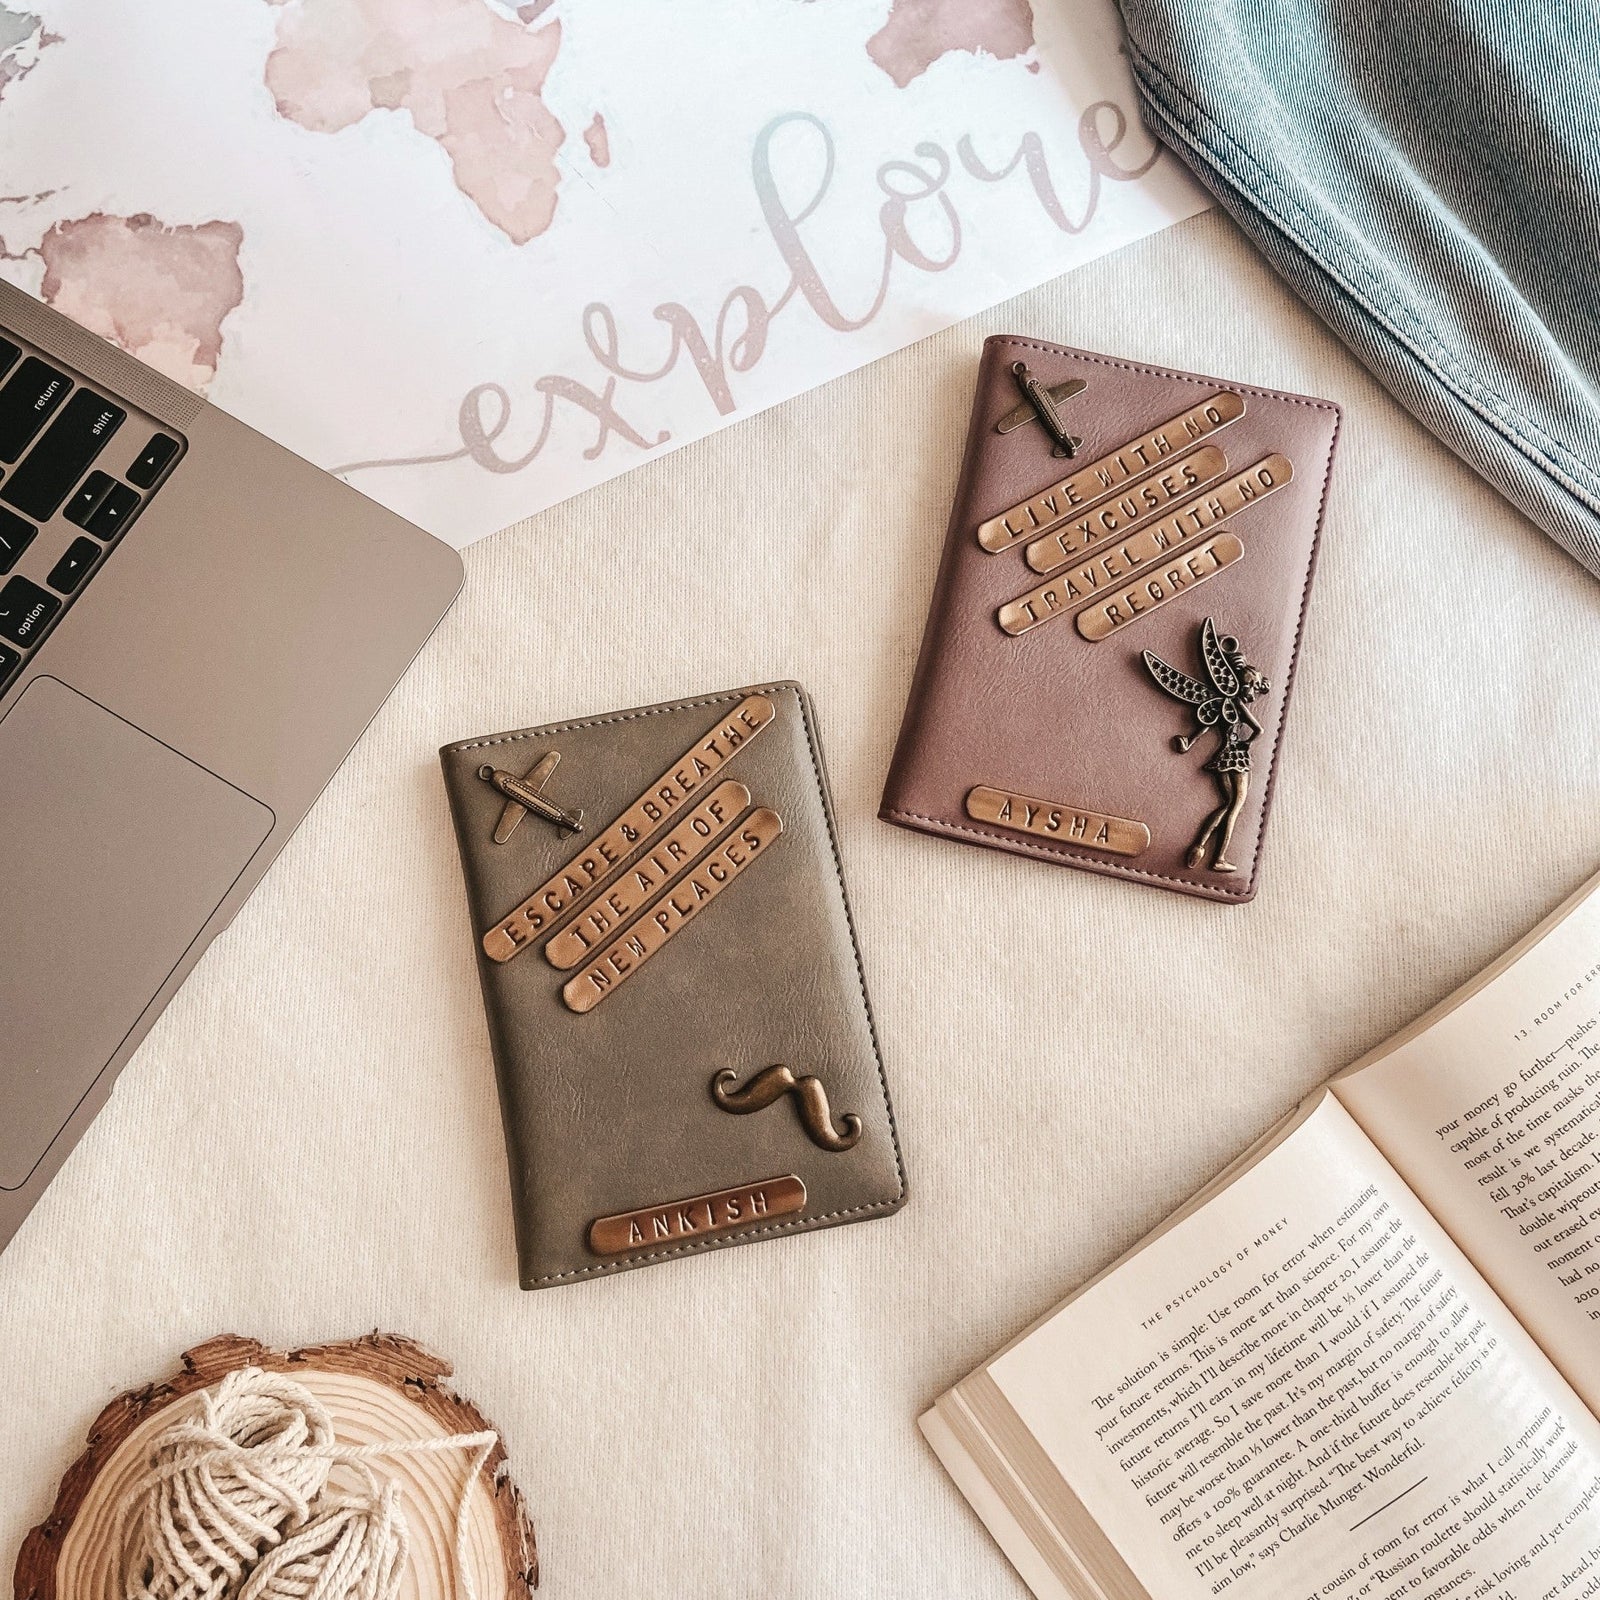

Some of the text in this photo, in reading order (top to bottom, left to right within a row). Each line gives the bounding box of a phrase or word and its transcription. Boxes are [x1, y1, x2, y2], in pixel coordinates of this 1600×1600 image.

[330, 100, 1162, 474] explore
[34, 380, 60, 411] return
[92, 411, 114, 435] shift
[1001, 406, 1222, 538] LIVE WITH NO
[1056, 464, 1198, 555] EXCUSES
[1019, 467, 1275, 622] TRAVEL WITH NO
[1102, 545, 1224, 626] REGRET
[18, 602, 45, 635] option
[502, 710, 760, 947] ESCAPE & BREATHE
[998, 798, 1109, 844] AYSHA
[570, 800, 727, 948] THE AIR OF
[588, 830, 761, 992] NEW PLACES
[1533, 1000, 1562, 1026] ROOM
[1564, 982, 1583, 1000] FOR
[1435, 1119, 1459, 1140] your
[1463, 1093, 1499, 1121] money
[1502, 1082, 1517, 1098] go
[1450, 1043, 1599, 1152] capable of producing ruin. The
[1463, 1070, 1600, 1169] most of the time masks the
[1477, 1145, 1540, 1186] result is we
[1489, 1186, 1510, 1203] fell
[1534, 1159, 1558, 1176] last
[1559, 1132, 1598, 1161] decade.
[1537, 1163, 1594, 1201] capitalism.
[629, 1191, 768, 1243] ANKISH
[1519, 1212, 1556, 1235] double
[1533, 1214, 1588, 1252] out erased
[1547, 1240, 1593, 1269] moment
[1091, 1184, 1378, 1409] The solution is simple: Use room for error when estimating
[1140, 1217, 1287, 1329] THE PSYCHOLOGY OF MONEY
[1557, 1262, 1599, 1286] had no
[1574, 1287, 1599, 1303] 2010
[1586, 1310, 1600, 1320] in
[1094, 1202, 1389, 1441] your future returns. This is more art than science. For my own
[1106, 1407, 1171, 1454] investments,
[1168, 1380, 1202, 1407] which
[1218, 1339, 1261, 1372] describe
[1260, 1319, 1288, 1342] more
[1286, 1310, 1301, 1322] in
[1301, 1279, 1338, 1312] chapter
[1339, 1269, 1356, 1282] 20,
[1350, 1257, 1360, 1269] I
[1360, 1232, 1391, 1263] assume
[1389, 1218, 1402, 1233] the
[1172, 1517, 1201, 1541] offers
[1203, 1510, 1212, 1519] a
[1242, 1451, 1295, 1493] guarantee.
[1296, 1438, 1308, 1452] A
[1310, 1400, 1359, 1442] one-third
[1357, 1379, 1391, 1406] buffer
[1390, 1370, 1403, 1382] is
[1404, 1337, 1439, 1371] enough
[1439, 1327, 1449, 1338] to
[1451, 1302, 1469, 1327] allow
[1211, 1552, 1228, 1564] be
[1229, 1513, 1279, 1557] pleasantly
[1280, 1476, 1331, 1516] surprised.
[1354, 1443, 1381, 1463] best
[1380, 1427, 1402, 1446] way
[1402, 1418, 1415, 1429] to
[1416, 1386, 1452, 1419] achieve
[1450, 1356, 1482, 1388] felicity
[1478, 1349, 1489, 1358] is
[1487, 1338, 1496, 1349] to
[1211, 1576, 1232, 1594] aim
[1258, 1540, 1280, 1559] says
[1278, 1512, 1320, 1542] Charlie
[1317, 1482, 1366, 1516] Munger.
[1362, 1437, 1425, 1482] Wonderful.
[1322, 1406, 1551, 1594] cousin of room for error is what I call optimism
[1358, 1583, 1371, 1595] or
[1420, 1522, 1461, 1554] roulette
[1462, 1490, 1497, 1524] should
[1497, 1446, 1547, 1496] statistically
[1408, 1441, 1577, 1588] to favorable odds when the downside
[1474, 1522, 1565, 1599] risk loving and yet
